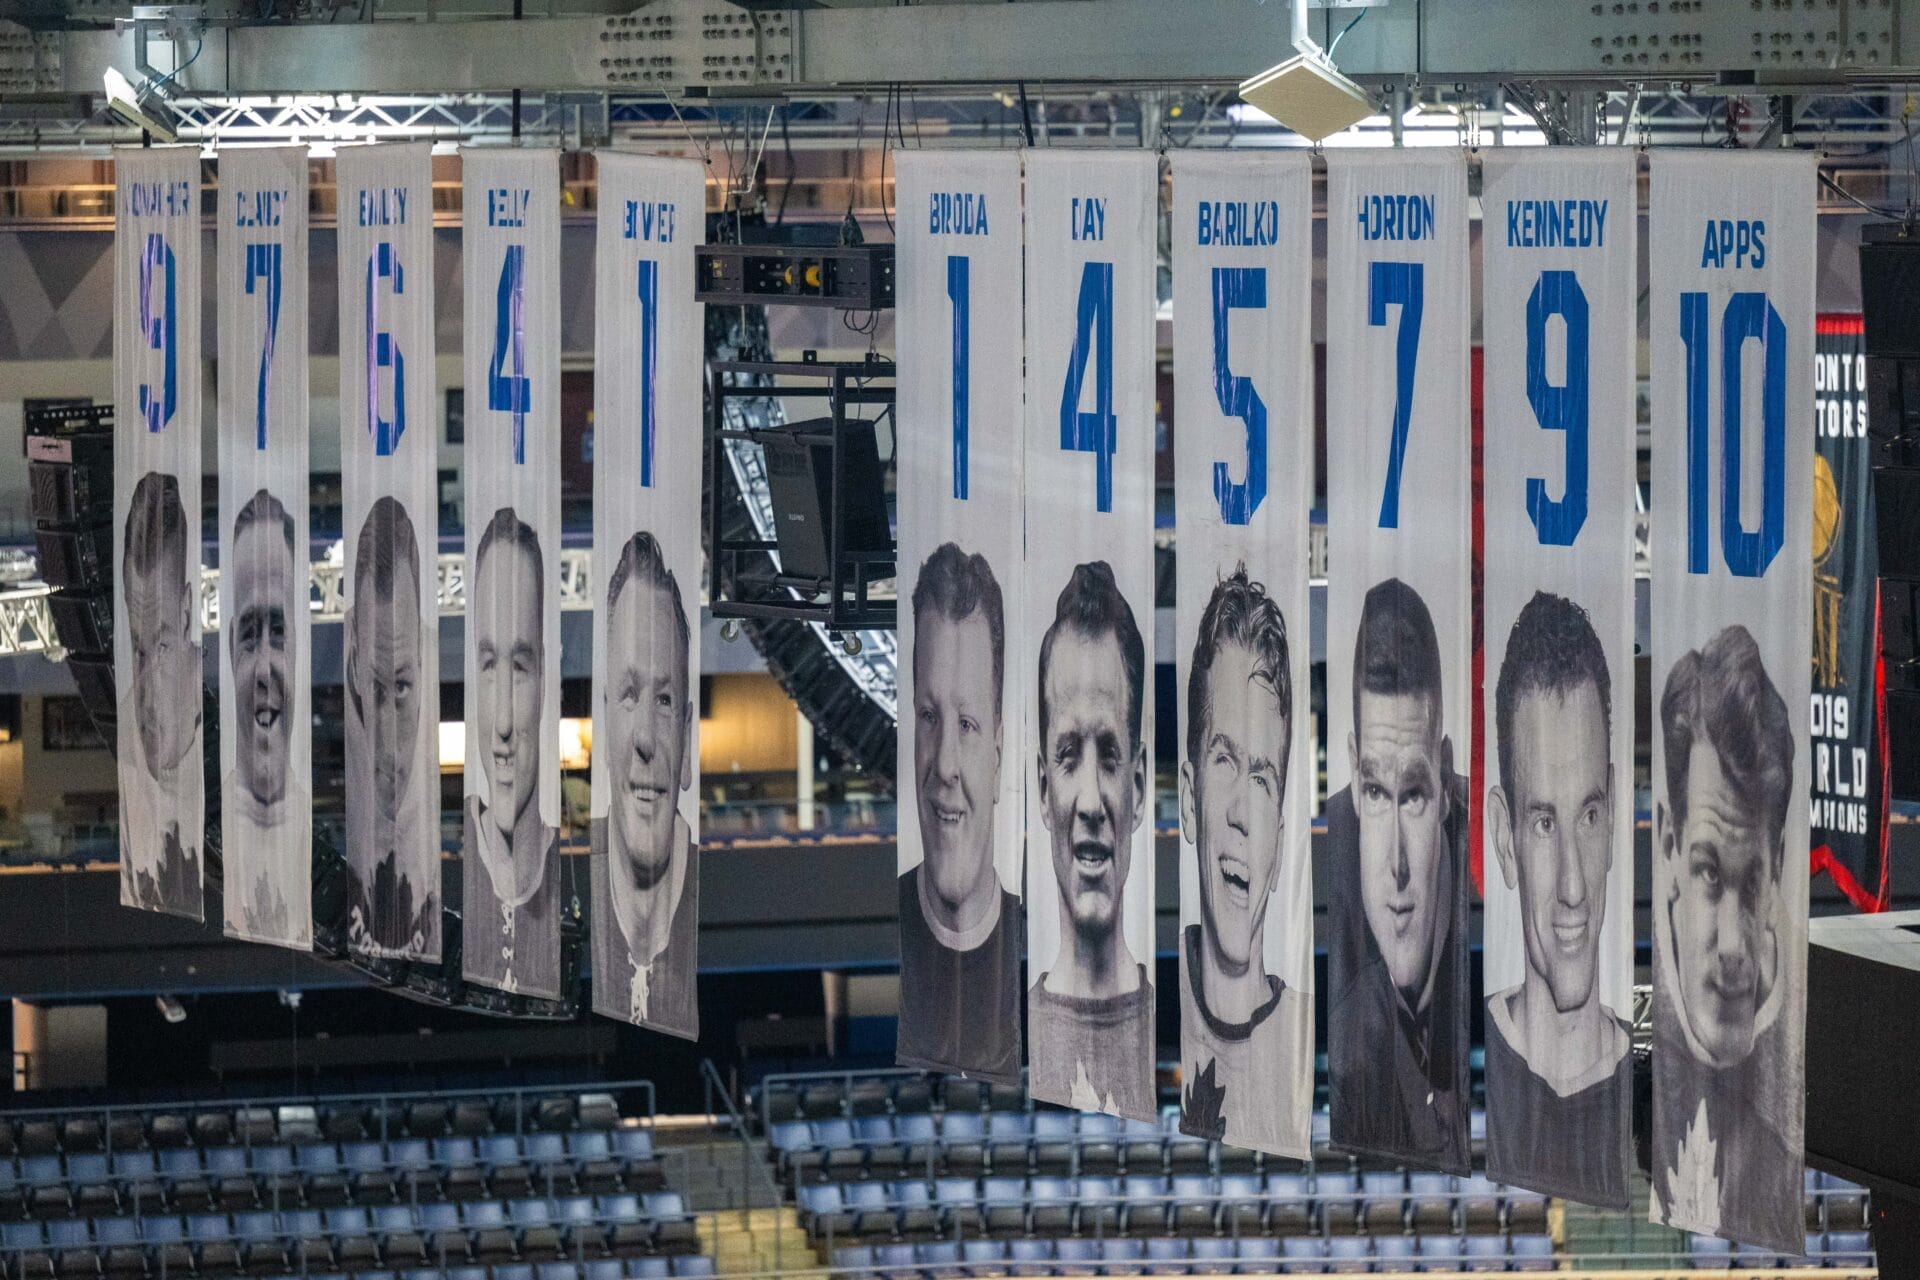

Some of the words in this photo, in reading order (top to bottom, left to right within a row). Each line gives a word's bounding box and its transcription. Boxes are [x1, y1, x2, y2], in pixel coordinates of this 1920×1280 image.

[930, 192, 988, 235] BRODA
[1198, 201, 1278, 246] BARILKO
[1358, 194, 1435, 241] HORTON
[1507, 200, 1608, 247] KENNEDY
[1701, 220, 1766, 269] APPS
[139, 233, 176, 434] 9
[245, 243, 282, 450] 7
[366, 243, 405, 456] 6
[489, 245, 531, 465] 4
[638, 260, 658, 489] 1
[947, 255, 969, 500] 1
[1060, 262, 1117, 513] 4
[1212, 267, 1267, 526] 5
[1368, 261, 1424, 529] 7
[1526, 270, 1589, 546] 9
[1680, 292, 1787, 578] 10
[1816, 399, 1867, 438] TORS
